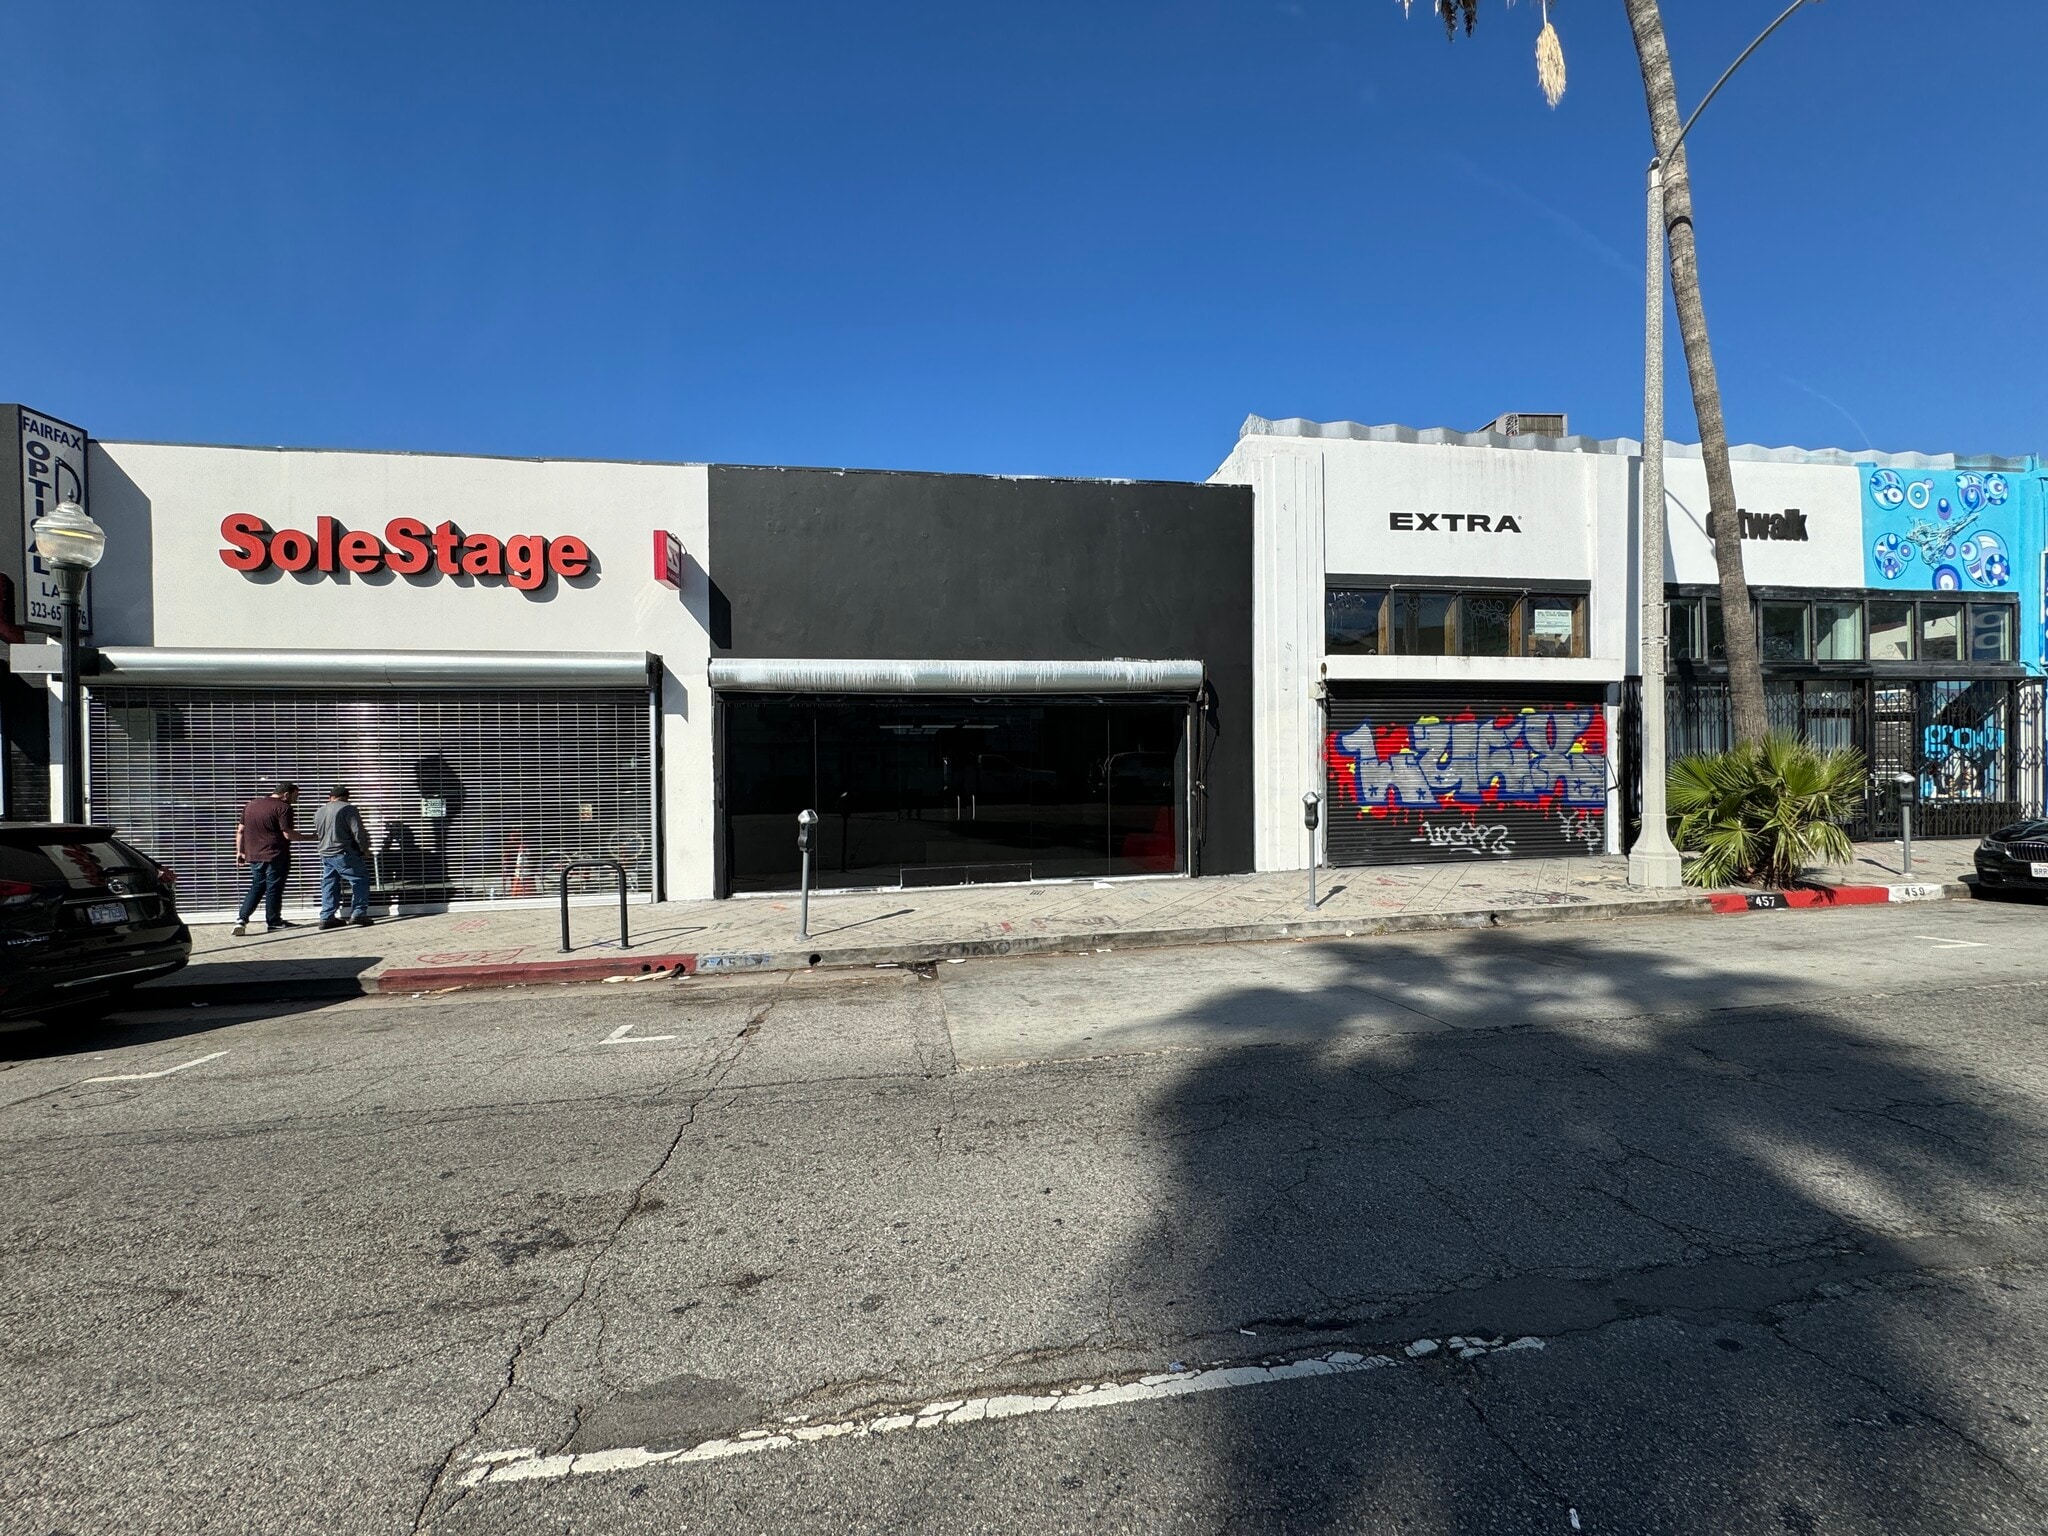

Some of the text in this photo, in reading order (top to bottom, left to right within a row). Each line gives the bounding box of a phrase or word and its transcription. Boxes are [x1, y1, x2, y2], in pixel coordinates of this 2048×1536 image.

[22, 415, 82, 452] FAIRFAX
[26, 440, 52, 576] OPTIL
[1389, 512, 1522, 533] EXTRA
[1706, 508, 1809, 542] twalk
[219, 513, 590, 591] SoleStage
[1755, 893, 1776, 907] 457
[1904, 886, 1926, 897] 459
